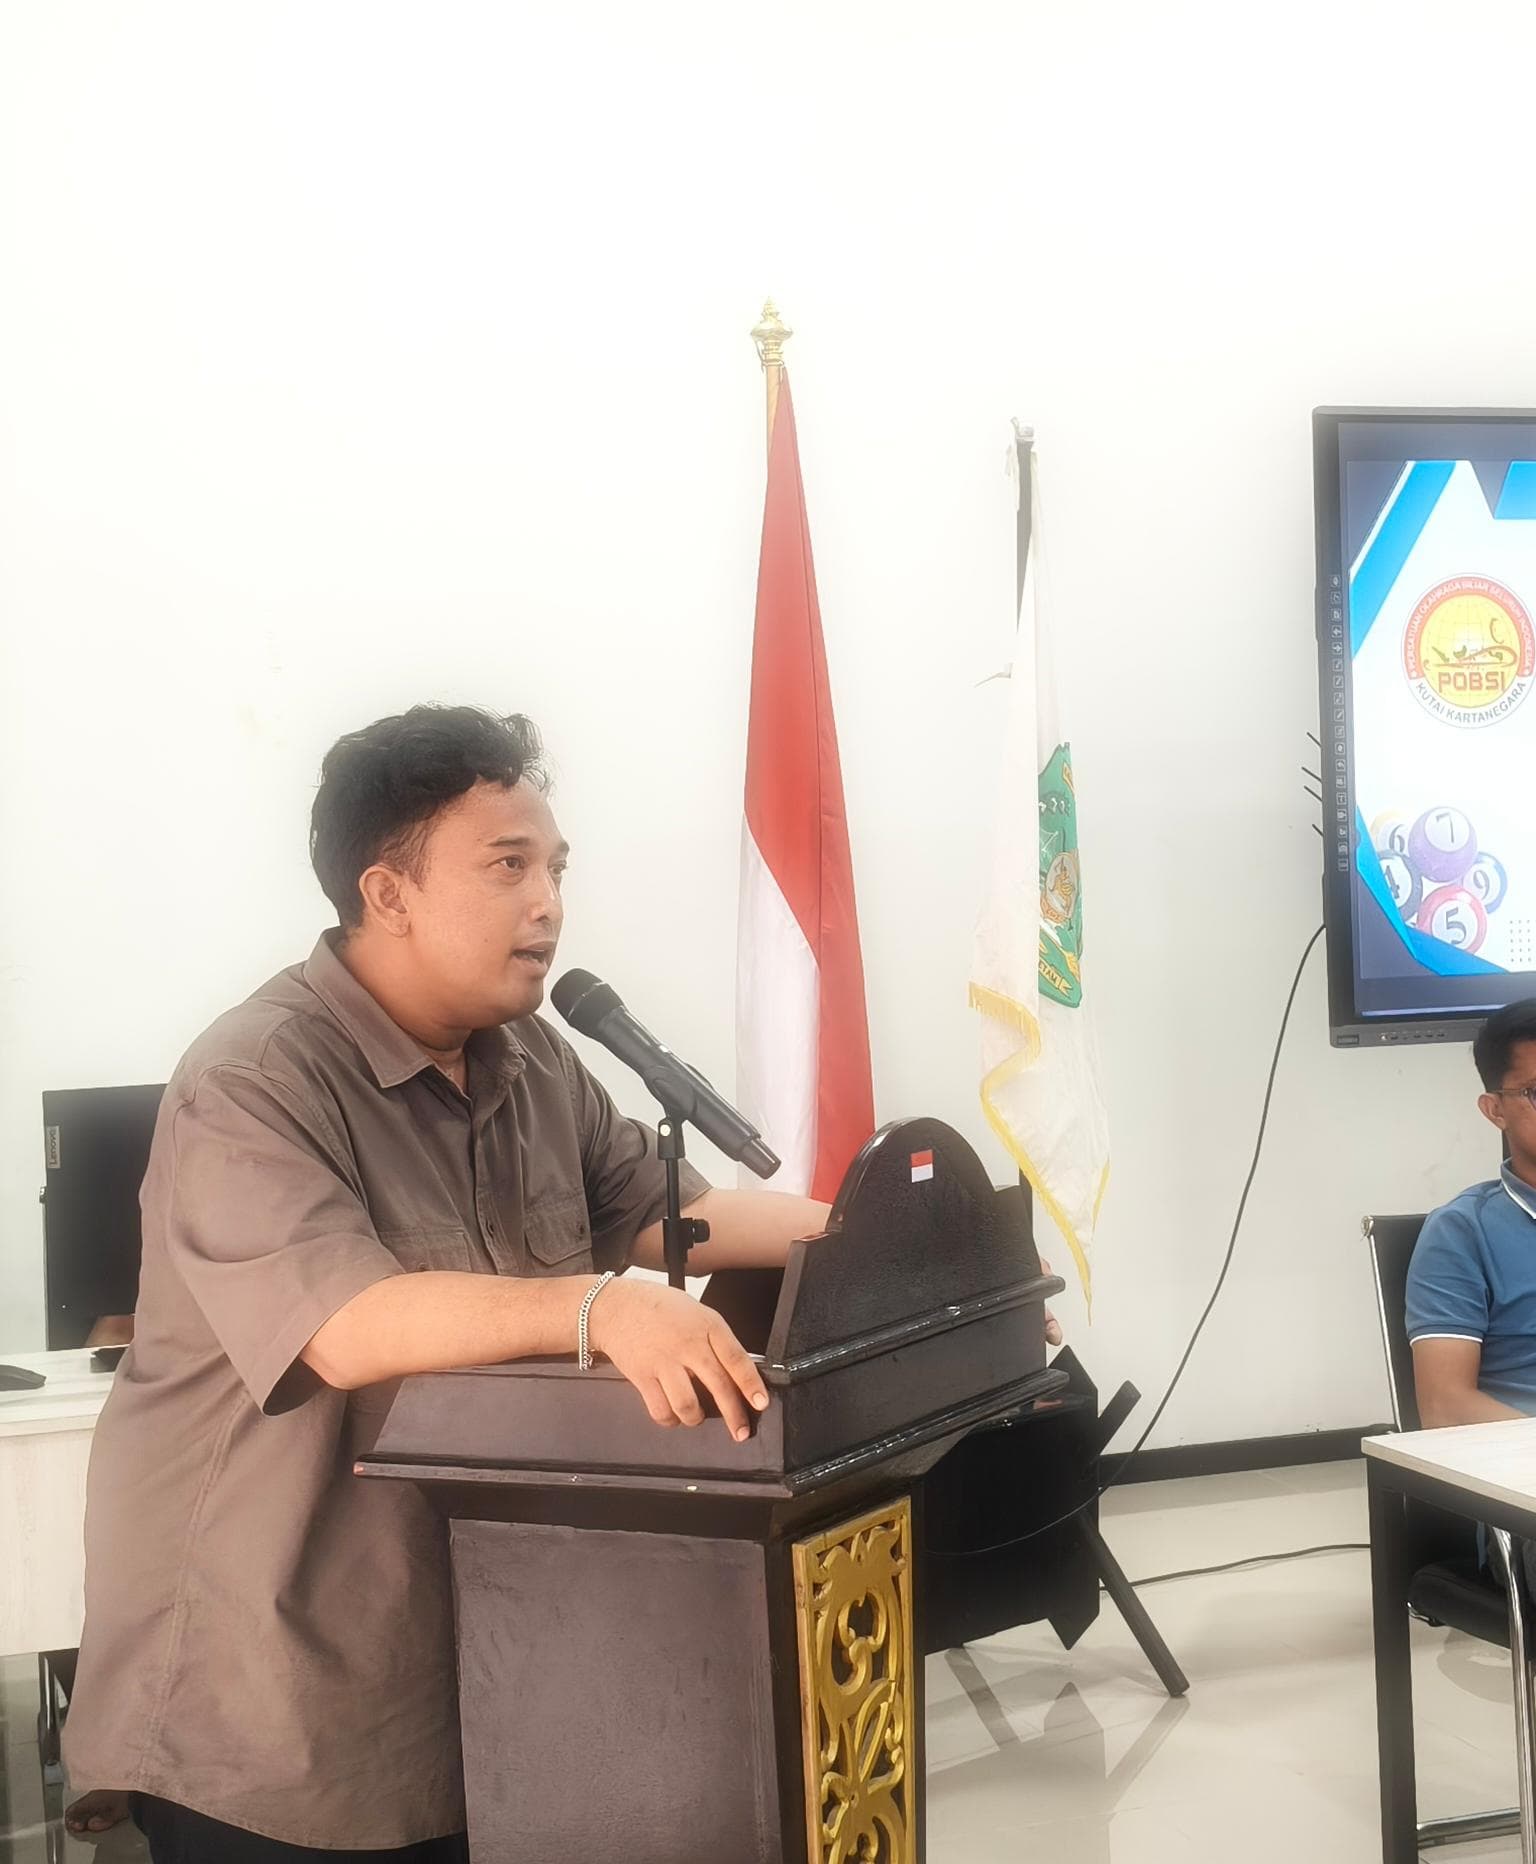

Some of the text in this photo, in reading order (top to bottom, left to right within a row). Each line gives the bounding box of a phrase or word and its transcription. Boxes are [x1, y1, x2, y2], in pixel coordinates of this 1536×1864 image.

[1438, 671, 1506, 693] POBSI
[1416, 682, 1526, 723] KUTAI KARTANEGARA
[1436, 813, 1455, 843] 7
[1446, 907, 1467, 945] 5
